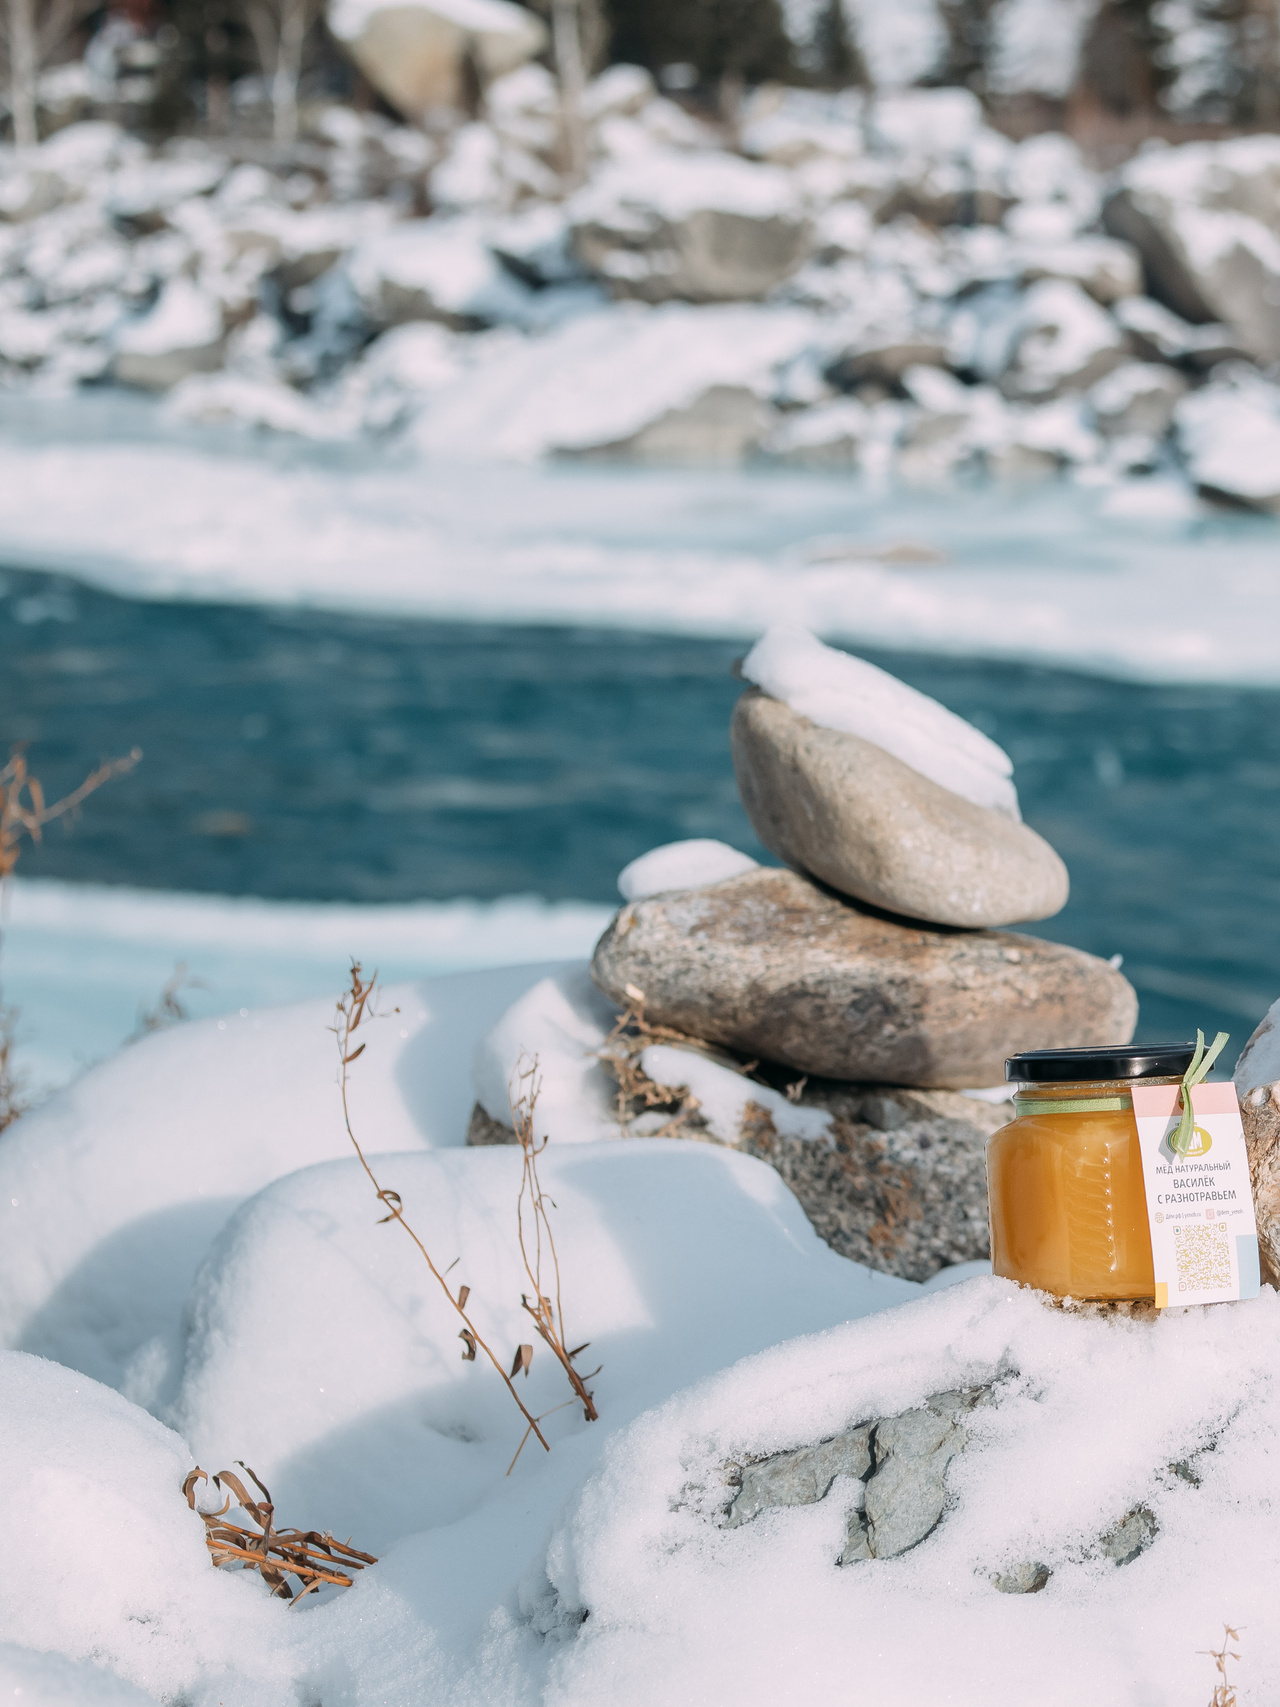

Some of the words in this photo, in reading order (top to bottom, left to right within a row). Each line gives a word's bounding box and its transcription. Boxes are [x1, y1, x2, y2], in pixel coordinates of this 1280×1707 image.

[1156, 1163, 1174, 1175] МЁД
[1175, 1160, 1231, 1174] НАТУРАЛЬНЫЙ
[1173, 1175, 1216, 1189] ВАСИЛЁК
[1157, 1194, 1163, 1204] С
[1165, 1189, 1237, 1204] РАЗНОТРАВЬЕМ
